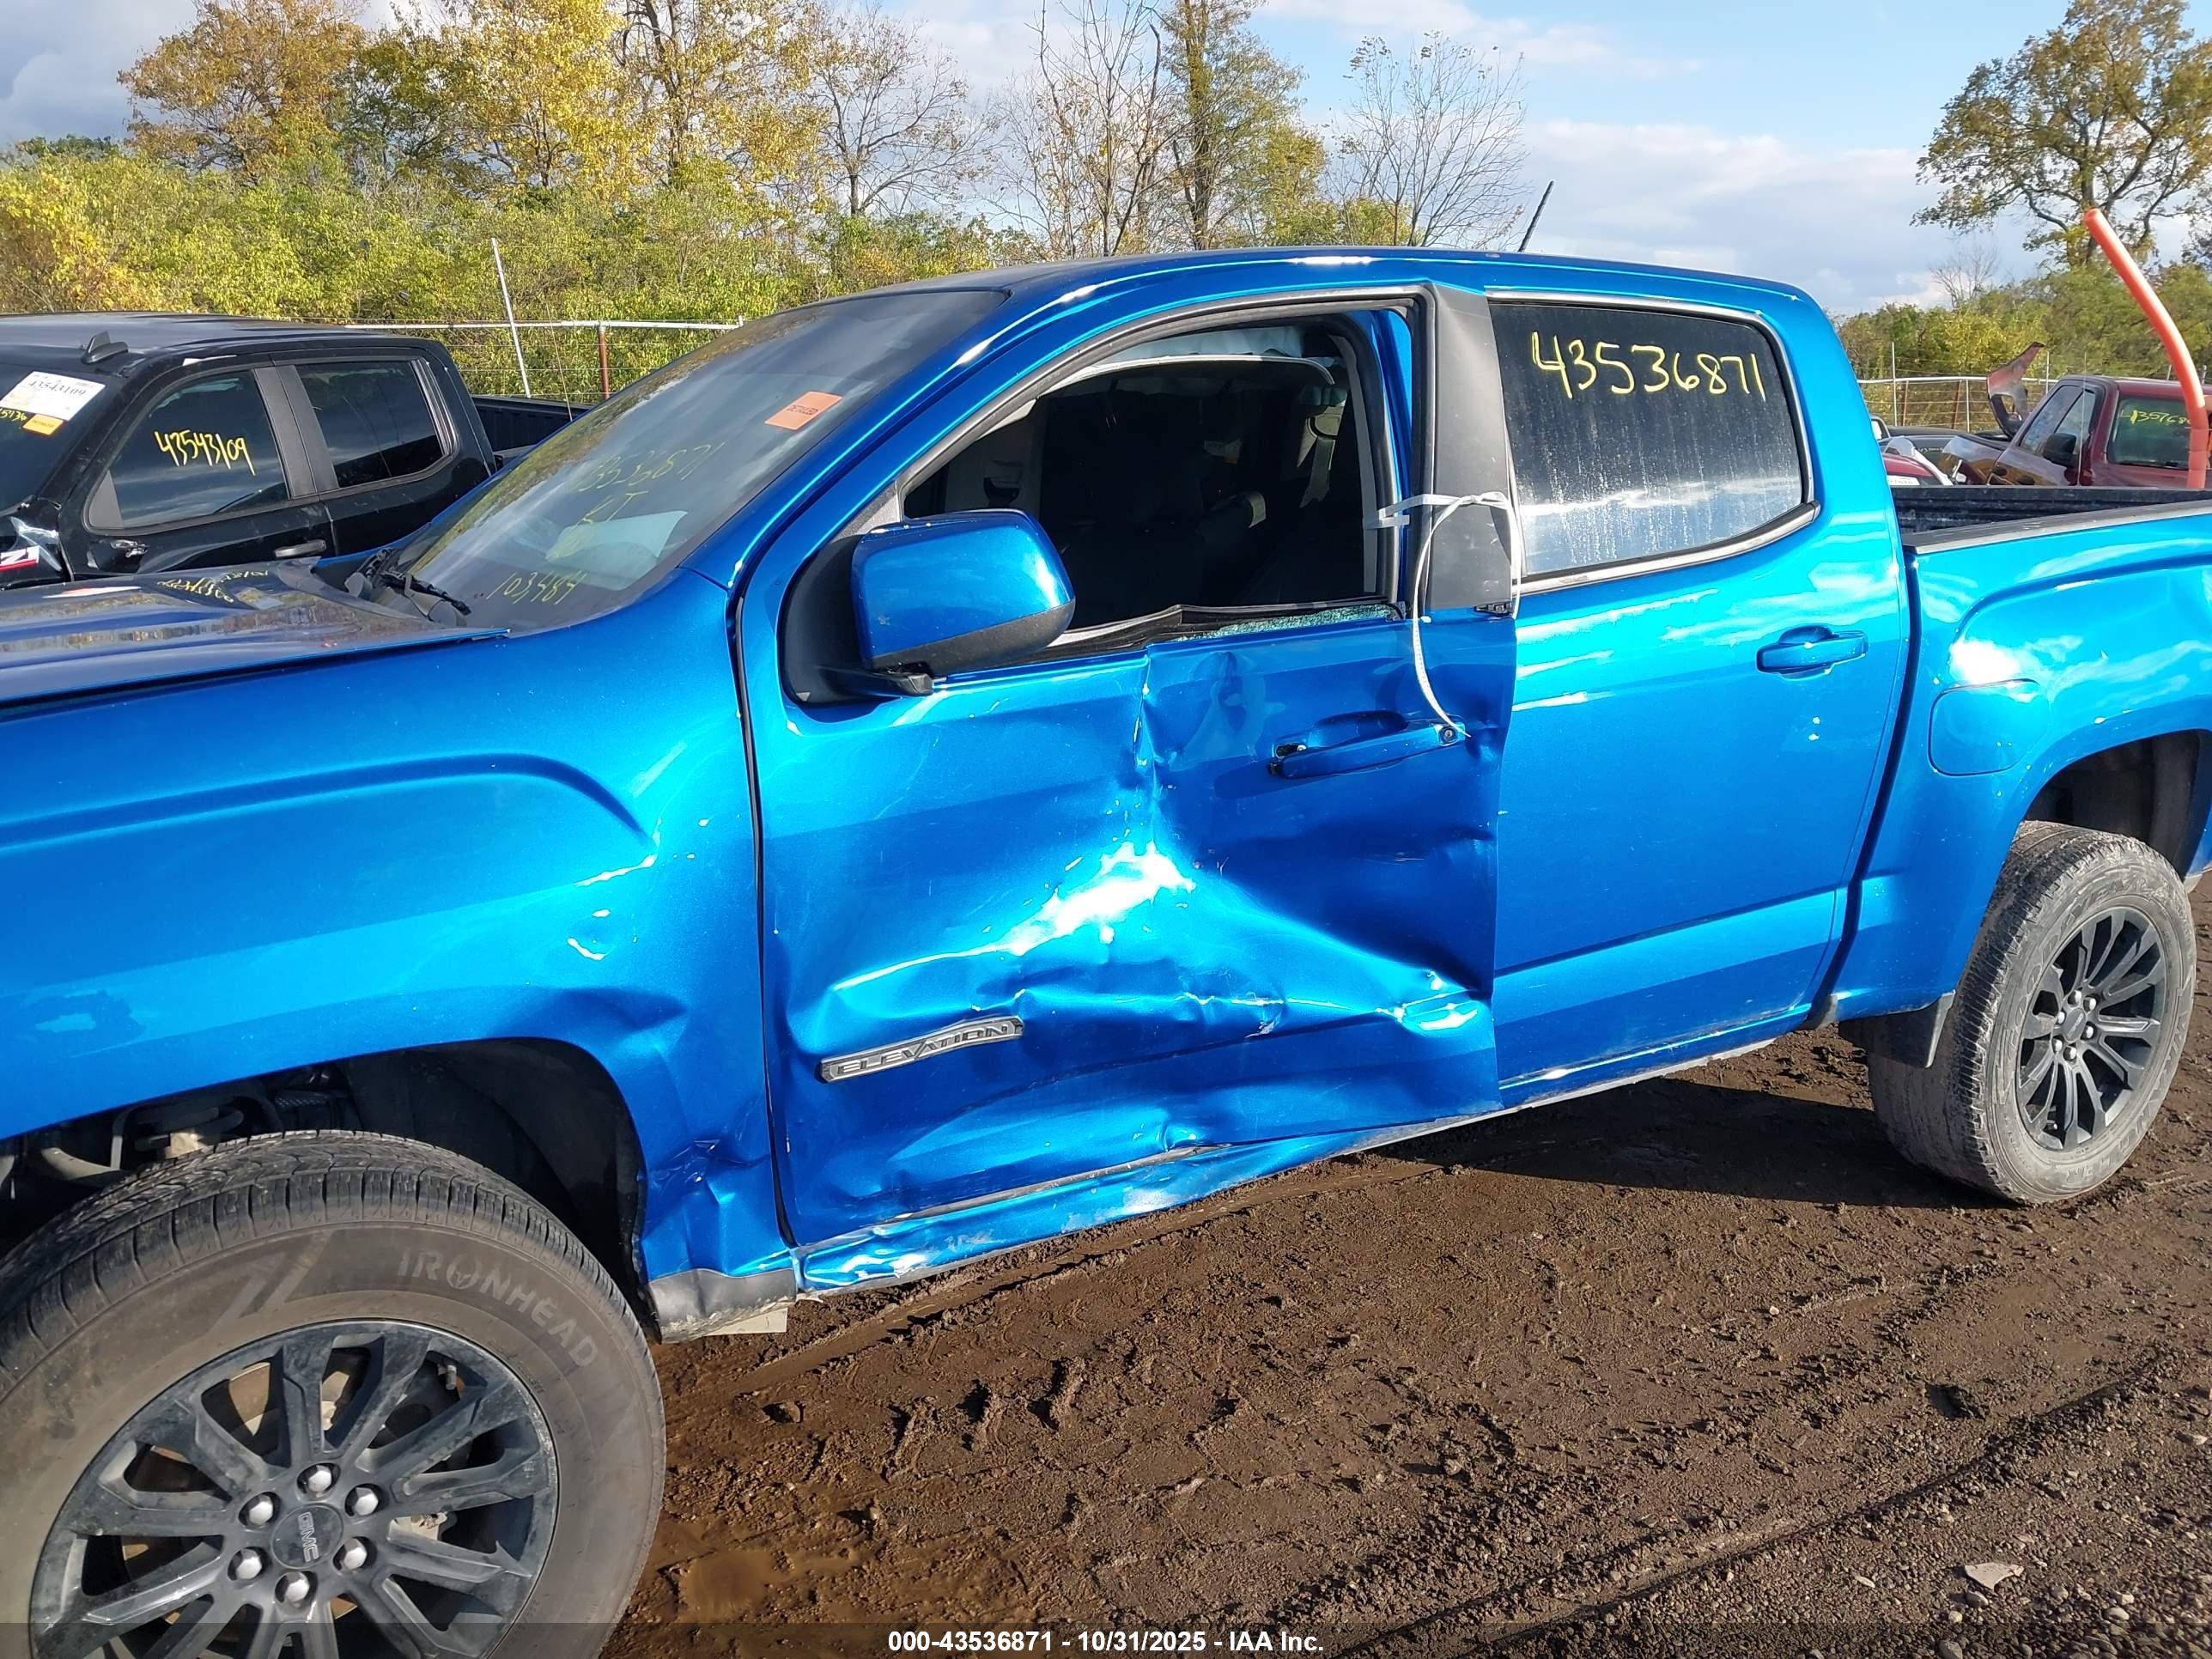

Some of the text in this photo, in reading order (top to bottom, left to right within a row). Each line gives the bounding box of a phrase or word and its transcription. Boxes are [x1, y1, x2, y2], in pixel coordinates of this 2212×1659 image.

[1530, 330, 1766, 402] 43536871
[153, 428, 257, 477] 43543109
[837, 1023, 1009, 1077] ELEVATION
[398, 1248, 599, 1367] IRONHEAD
